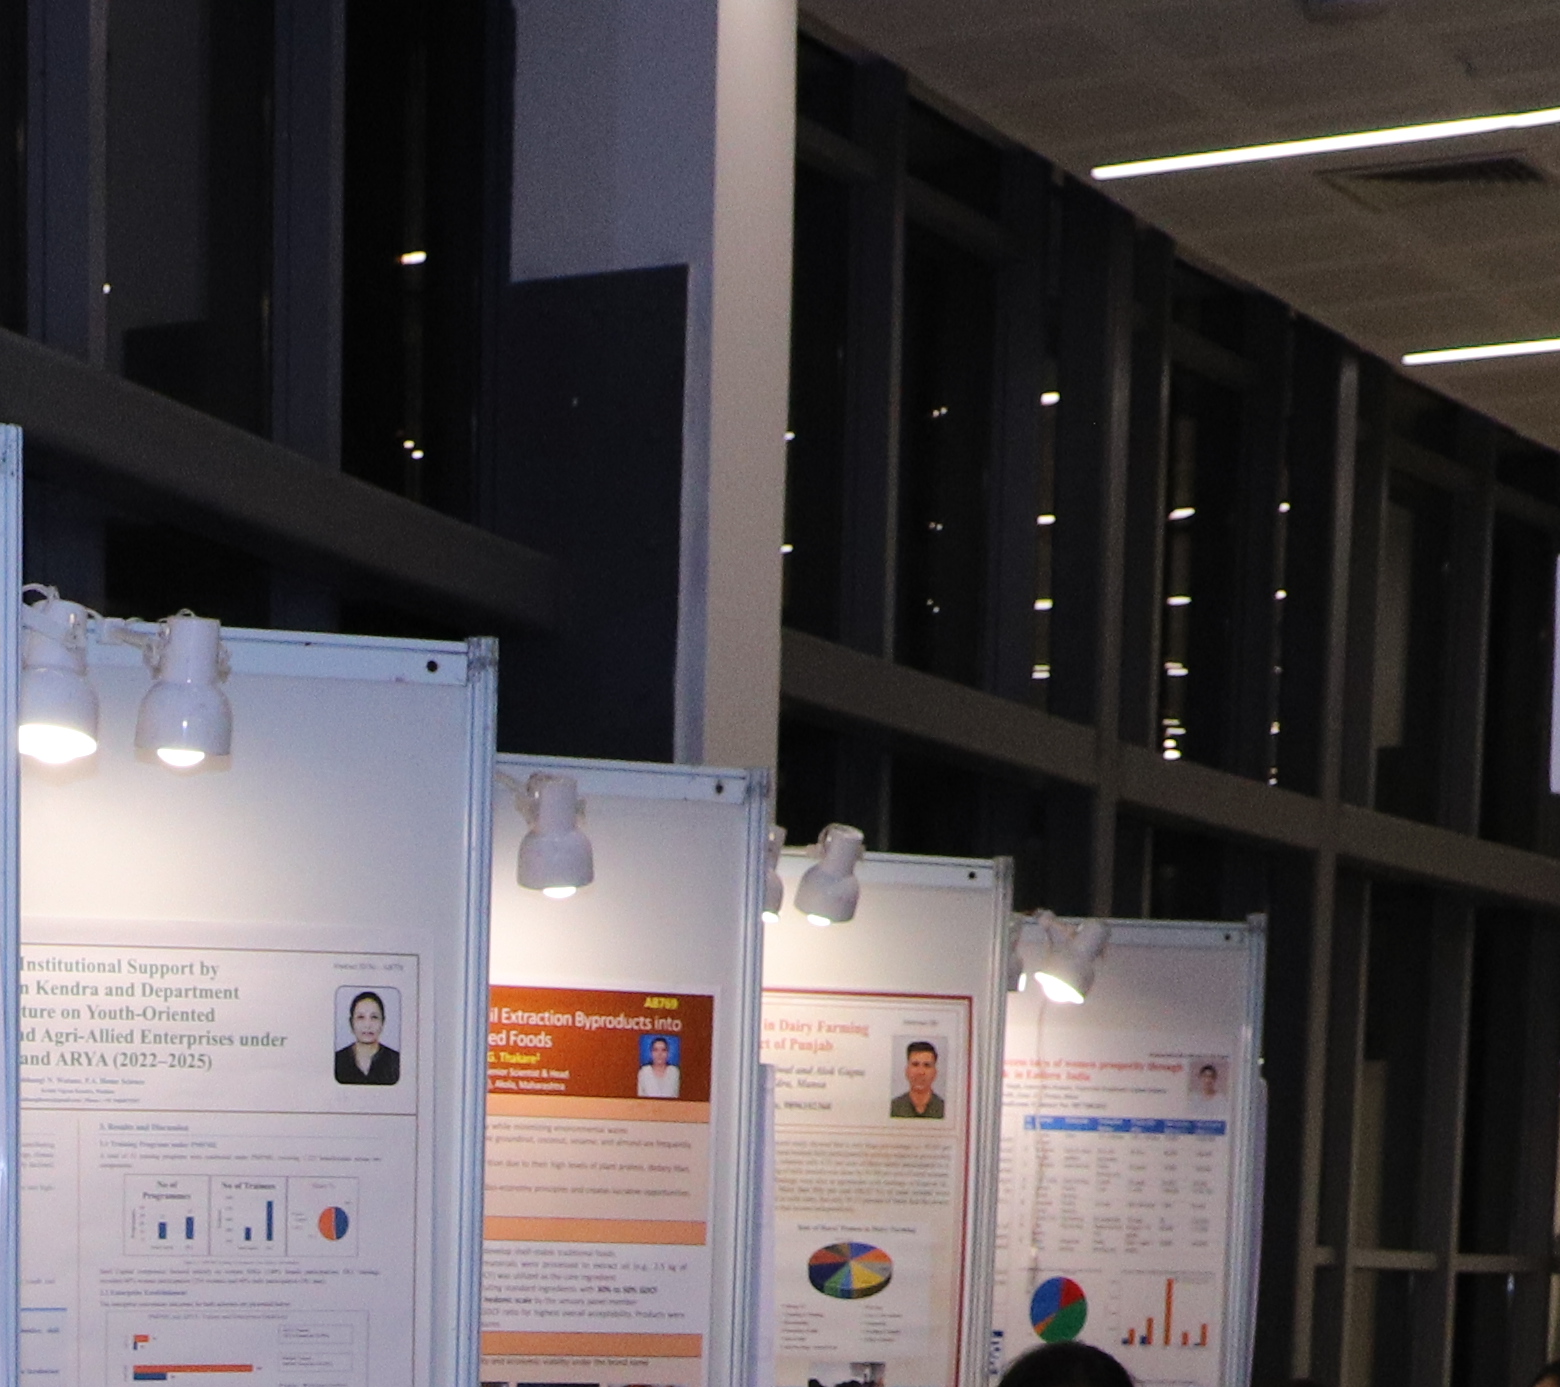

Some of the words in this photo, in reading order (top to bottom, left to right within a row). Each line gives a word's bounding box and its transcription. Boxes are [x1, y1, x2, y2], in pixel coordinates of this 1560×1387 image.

[127, 960, 194, 979] Support
[200, 961, 220, 981] by
[36, 979, 99, 997] Kendra
[104, 982, 135, 998] and
[141, 983, 241, 1001] Department
[60, 1008, 81, 1020] on
[86, 1004, 216, 1023] Youth-Oriented
[502, 1008, 573, 1027] Extraction
[575, 1012, 652, 1031] Byproducts
[655, 1016, 682, 1032] into
[40, 1027, 134, 1047] Agri-Allied
[140, 1028, 235, 1050] Enterprises
[239, 1031, 288, 1048] under
[509, 1032, 553, 1048] Foods
[58, 1052, 110, 1068] ARYA
